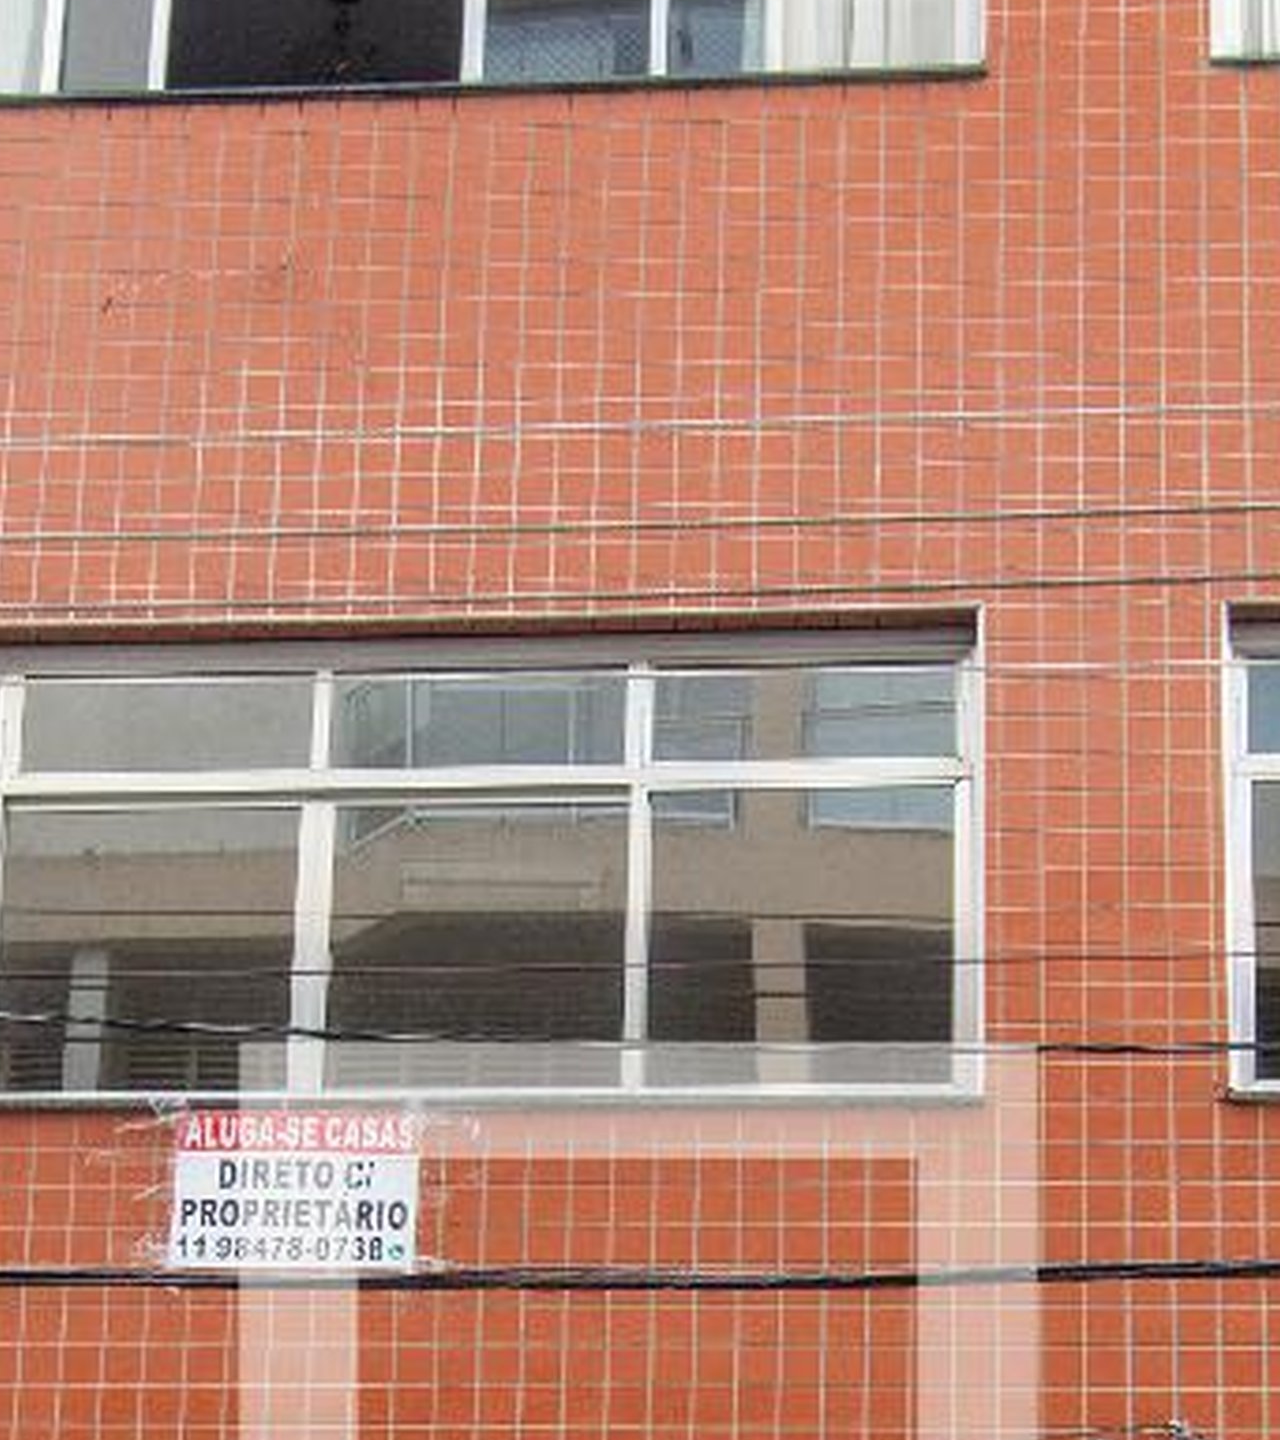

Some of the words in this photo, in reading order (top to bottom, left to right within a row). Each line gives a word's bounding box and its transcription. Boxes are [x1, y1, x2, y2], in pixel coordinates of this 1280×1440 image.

[184, 1113, 318, 1148] ALUGA-SE
[323, 1112, 414, 1148] CASAS
[219, 1160, 334, 1190] DIRETO
[176, 1234, 206, 1258] 11
